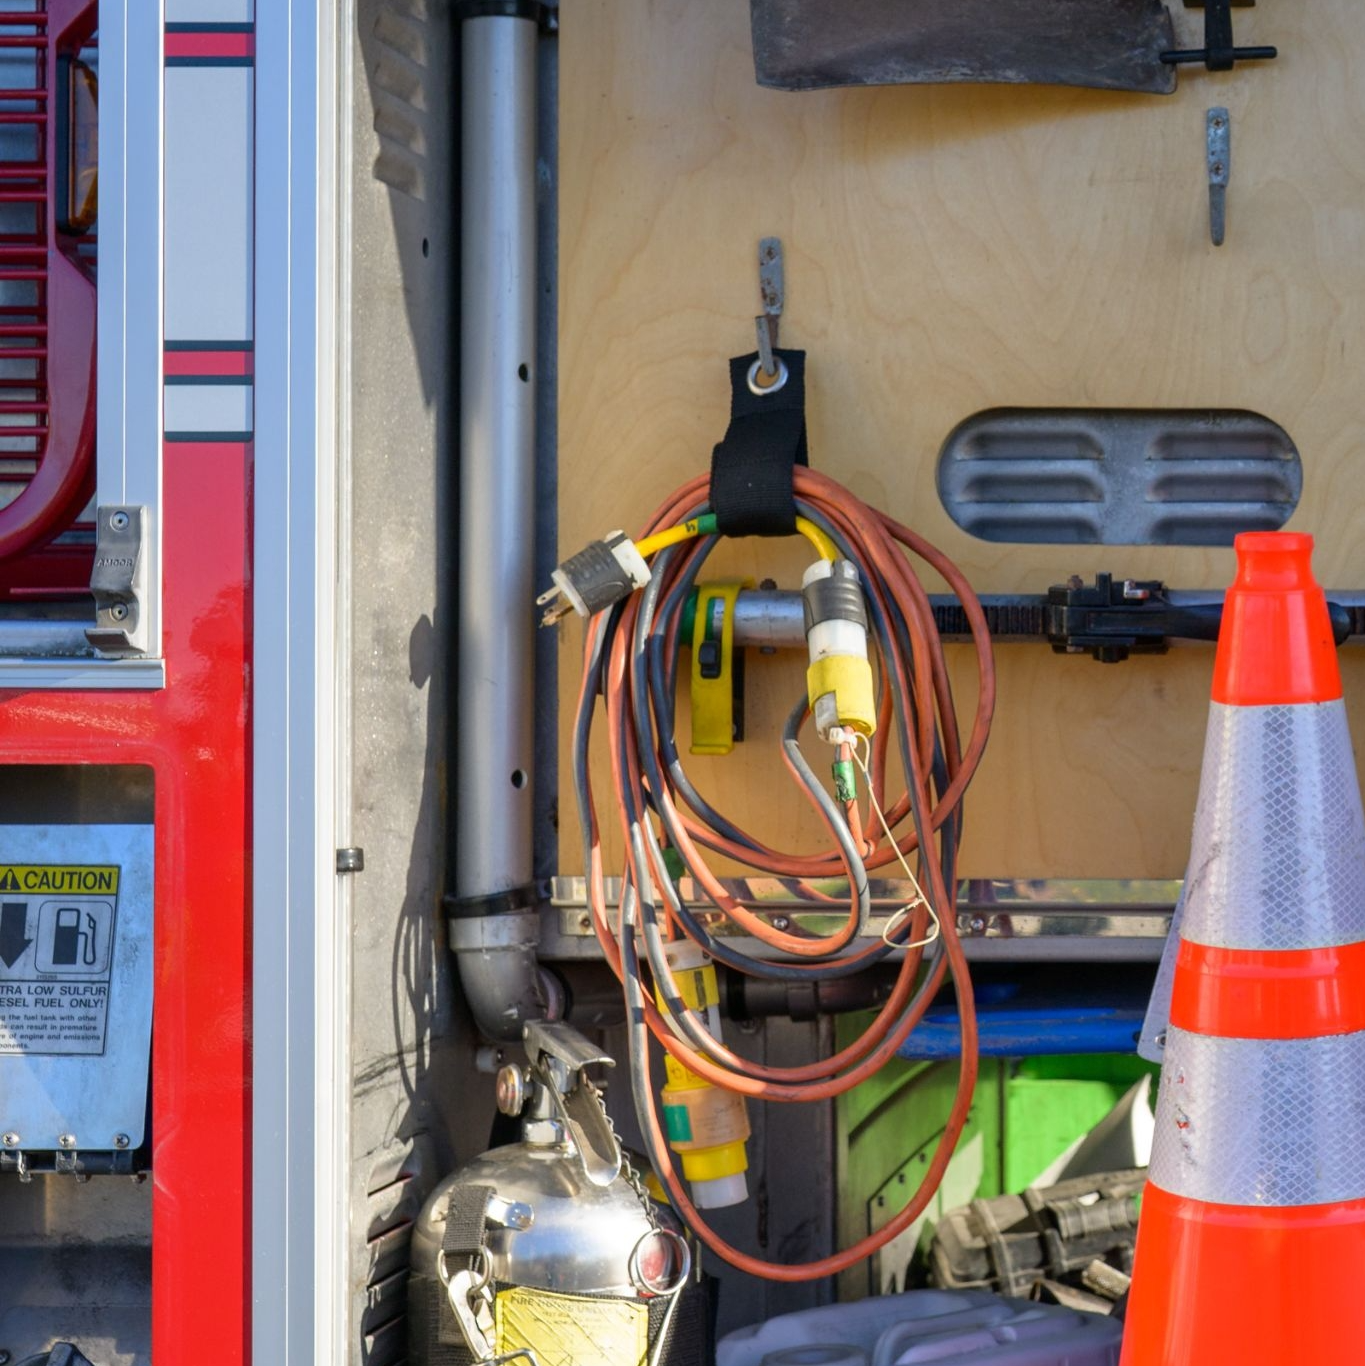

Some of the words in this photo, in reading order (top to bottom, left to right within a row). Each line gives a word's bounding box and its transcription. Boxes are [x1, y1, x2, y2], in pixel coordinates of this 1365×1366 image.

[24, 870, 112, 890] CAUTION
[27, 985, 58, 995] LOW
[60, 985, 107, 996] SULFUR
[34, 998, 64, 1007] FUEL
[70, 998, 103, 1008] ONLY!
[60, 1024, 97, 1032] premature
